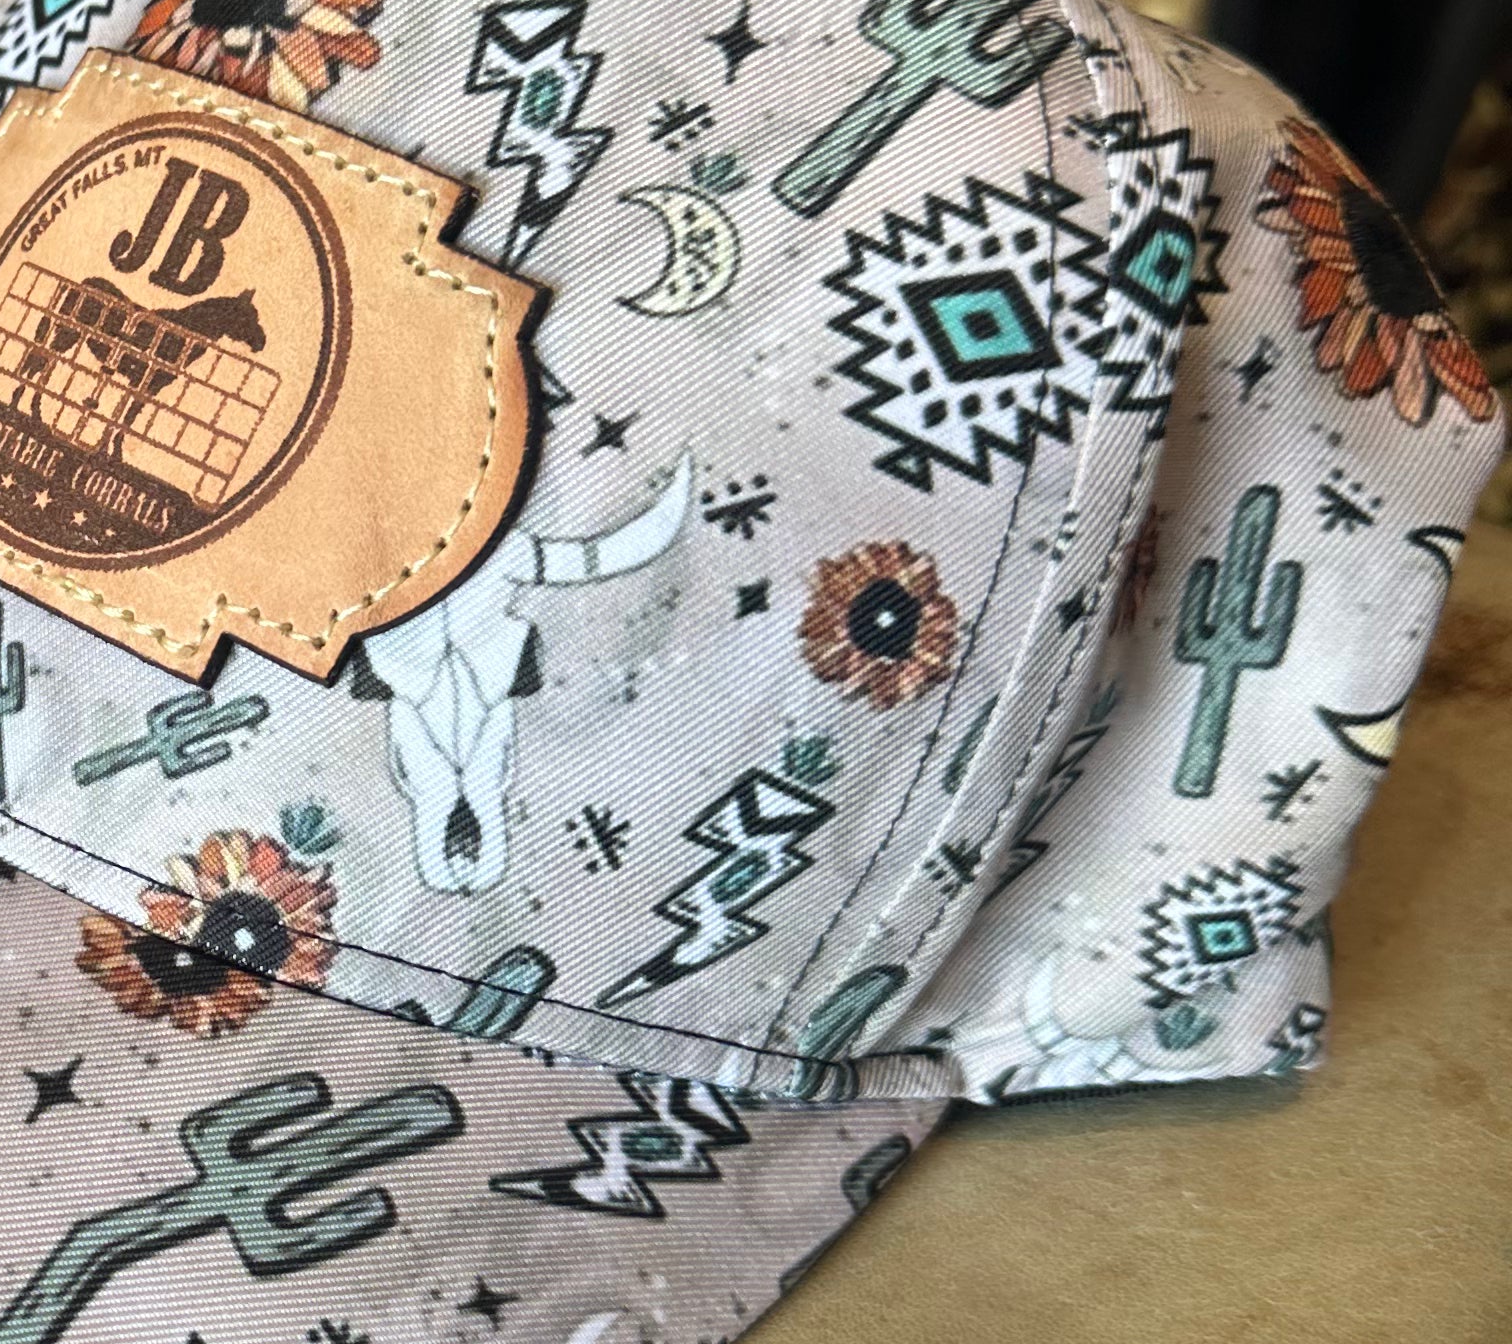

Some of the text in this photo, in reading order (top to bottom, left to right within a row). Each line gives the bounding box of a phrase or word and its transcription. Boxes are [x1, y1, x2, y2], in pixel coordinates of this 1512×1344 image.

[21, 190, 67, 252] GREAT
[134, 145, 166, 168] MT
[108, 156, 251, 296] JB
[72, 462, 175, 534] CORRALS
